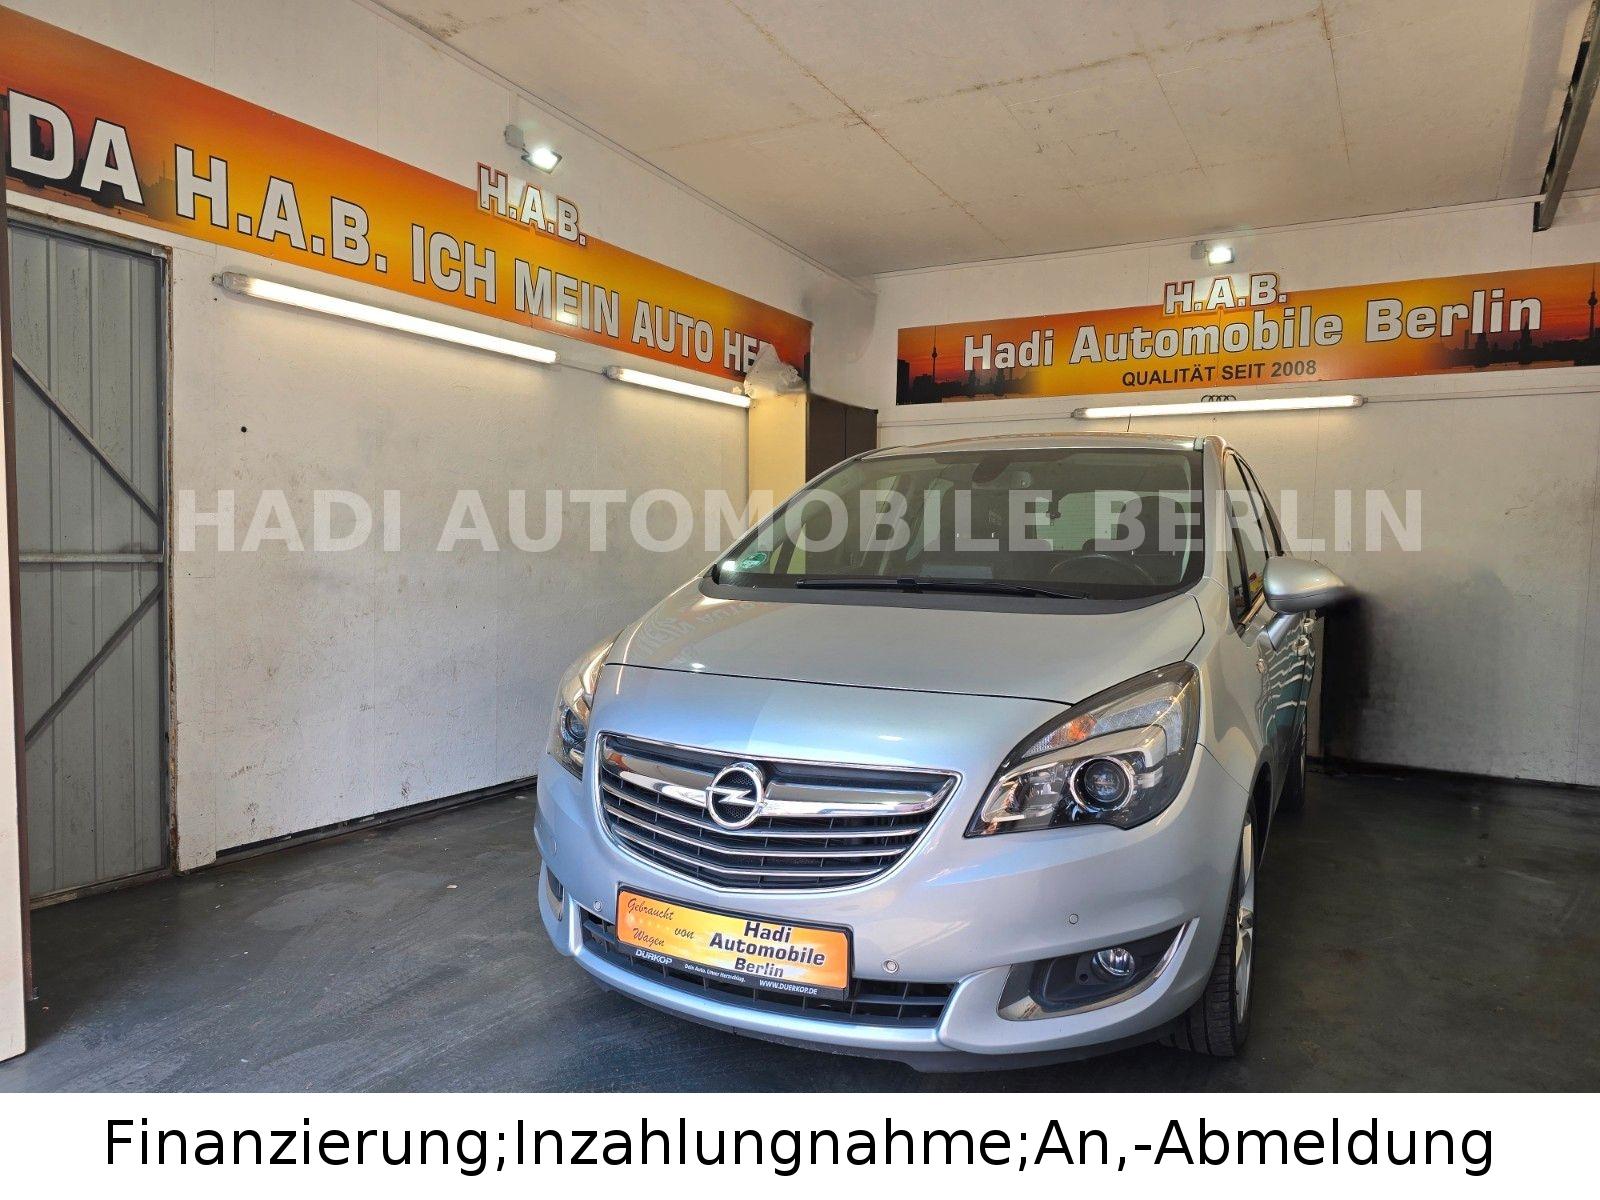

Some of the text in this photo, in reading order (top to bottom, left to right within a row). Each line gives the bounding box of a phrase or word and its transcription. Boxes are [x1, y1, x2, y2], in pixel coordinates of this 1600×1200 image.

[478, 163, 587, 247] H.A.B.
[7, 87, 773, 377] DA H.A.B. ICH MEIN AUTO HE
[1164, 273, 1287, 316] H.A.B.
[964, 287, 1542, 371] Hadi Automobile Berlin
[1122, 359, 1317, 387] QUALITÄT SEIT 2008
[627, 898, 674, 921] Gebraucht
[633, 927, 665, 948] Wagen
[674, 927, 695, 939] von
[743, 921, 792, 943] Hadi
[709, 932, 826, 966] Automobile
[734, 957, 784, 978] Berlin
